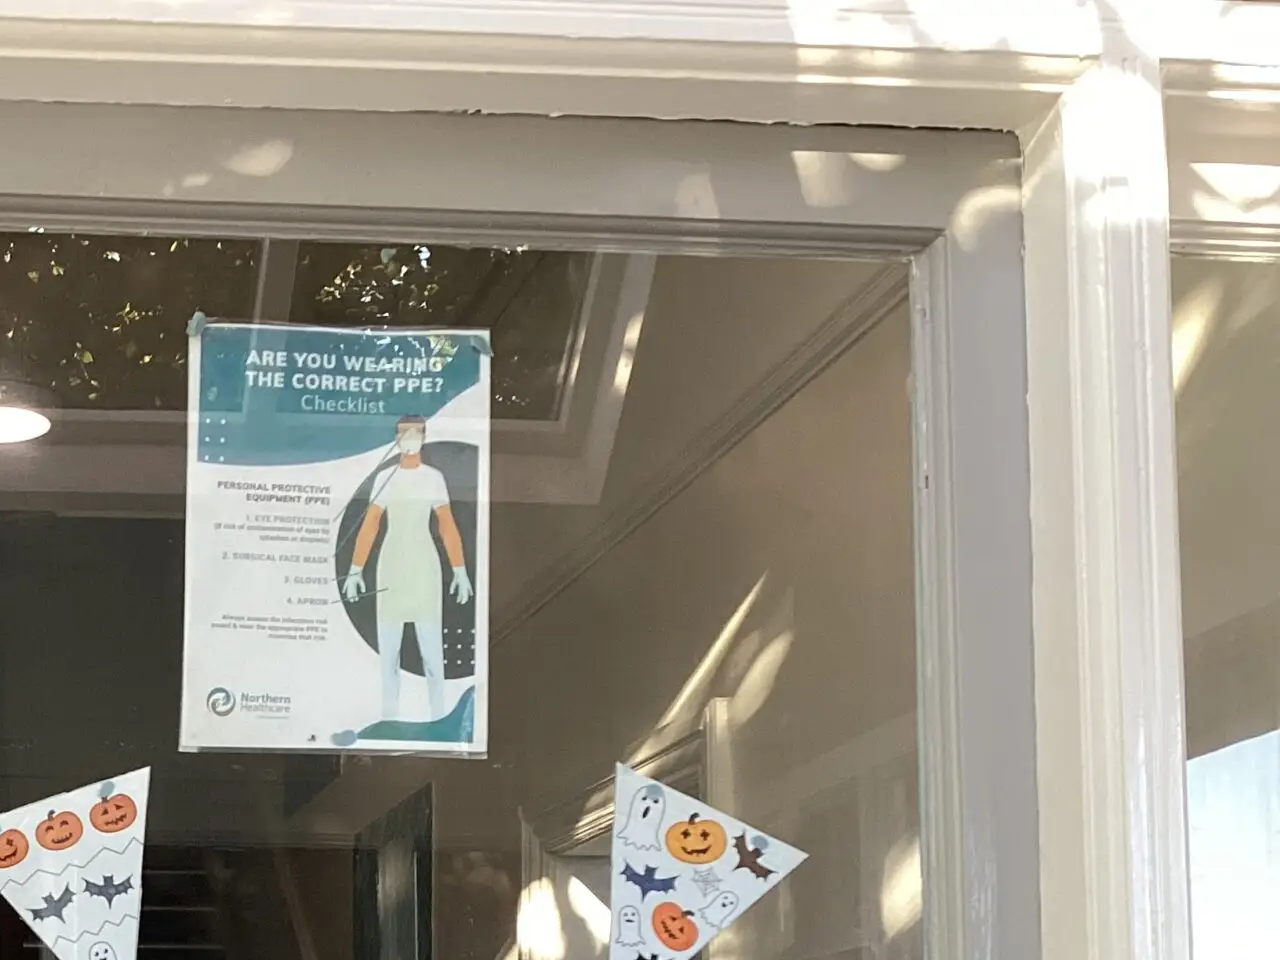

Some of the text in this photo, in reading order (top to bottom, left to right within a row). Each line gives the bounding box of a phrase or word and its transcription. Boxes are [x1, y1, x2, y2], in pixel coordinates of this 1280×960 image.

[245, 350, 443, 374] ARE YOU WEARING
[245, 370, 445, 394] THE CORRECT PPE?
[301, 394, 387, 413] Checklist
[217, 480, 331, 494] PERSONAL PROTECTIVE
[246, 493, 302, 503] EQUIPMENT
[240, 692, 291, 704] Northern
[240, 702, 291, 714] Healthcare
